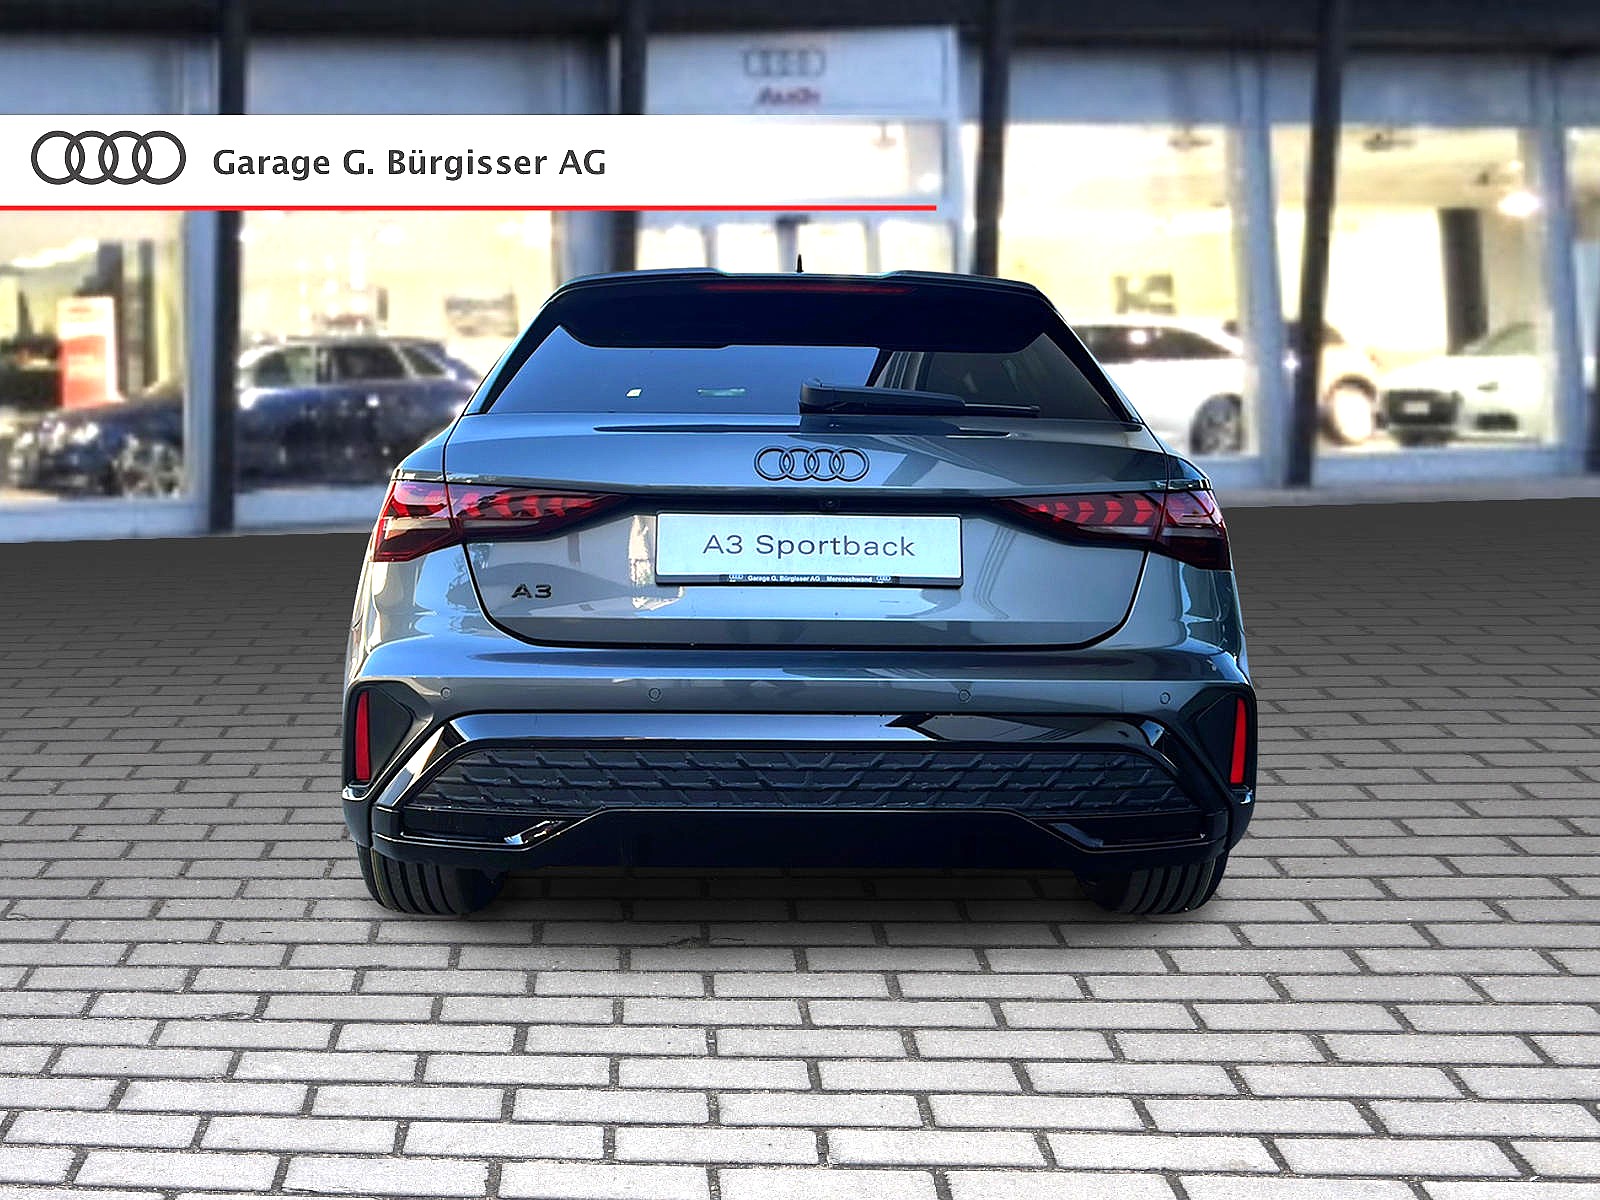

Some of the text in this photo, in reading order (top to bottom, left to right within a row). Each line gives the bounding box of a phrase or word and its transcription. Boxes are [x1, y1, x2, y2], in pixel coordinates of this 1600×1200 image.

[702, 534, 915, 560] A3 Sportback
[747, 575, 770, 583] Garage
[511, 583, 552, 599] A3
